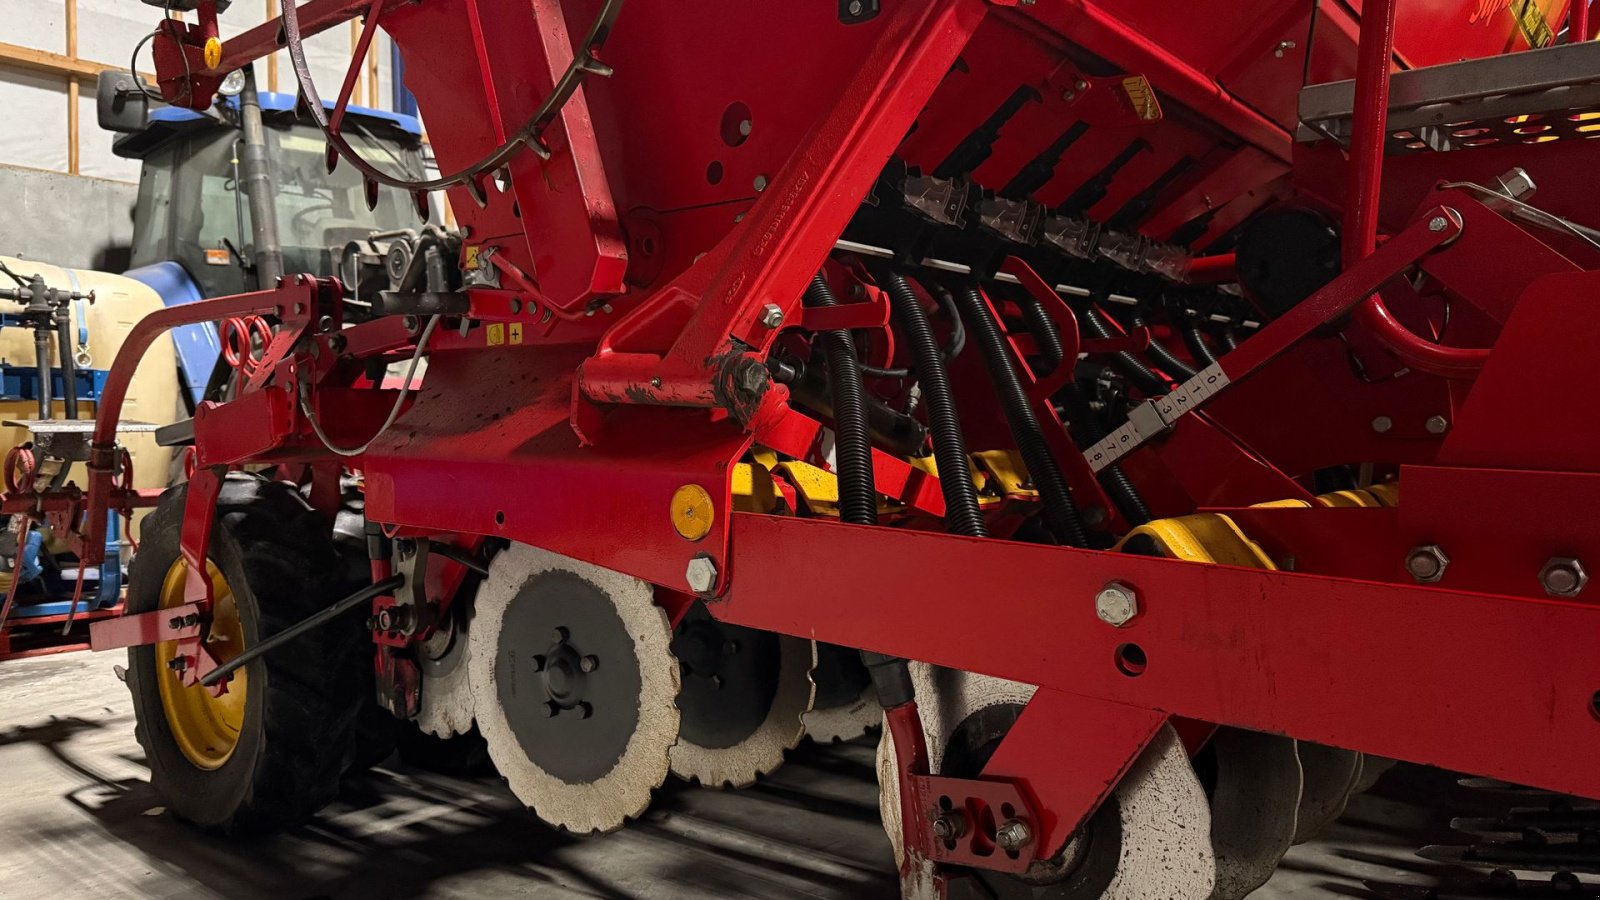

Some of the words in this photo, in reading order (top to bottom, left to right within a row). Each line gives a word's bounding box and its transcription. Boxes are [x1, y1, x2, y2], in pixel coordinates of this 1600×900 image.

[1207, 375, 1217, 384] 0
[1177, 395, 1187, 405] 2
[1163, 405, 1172, 414] 3
[1120, 434, 1130, 443] 6
[1093, 452, 1103, 461] 8
